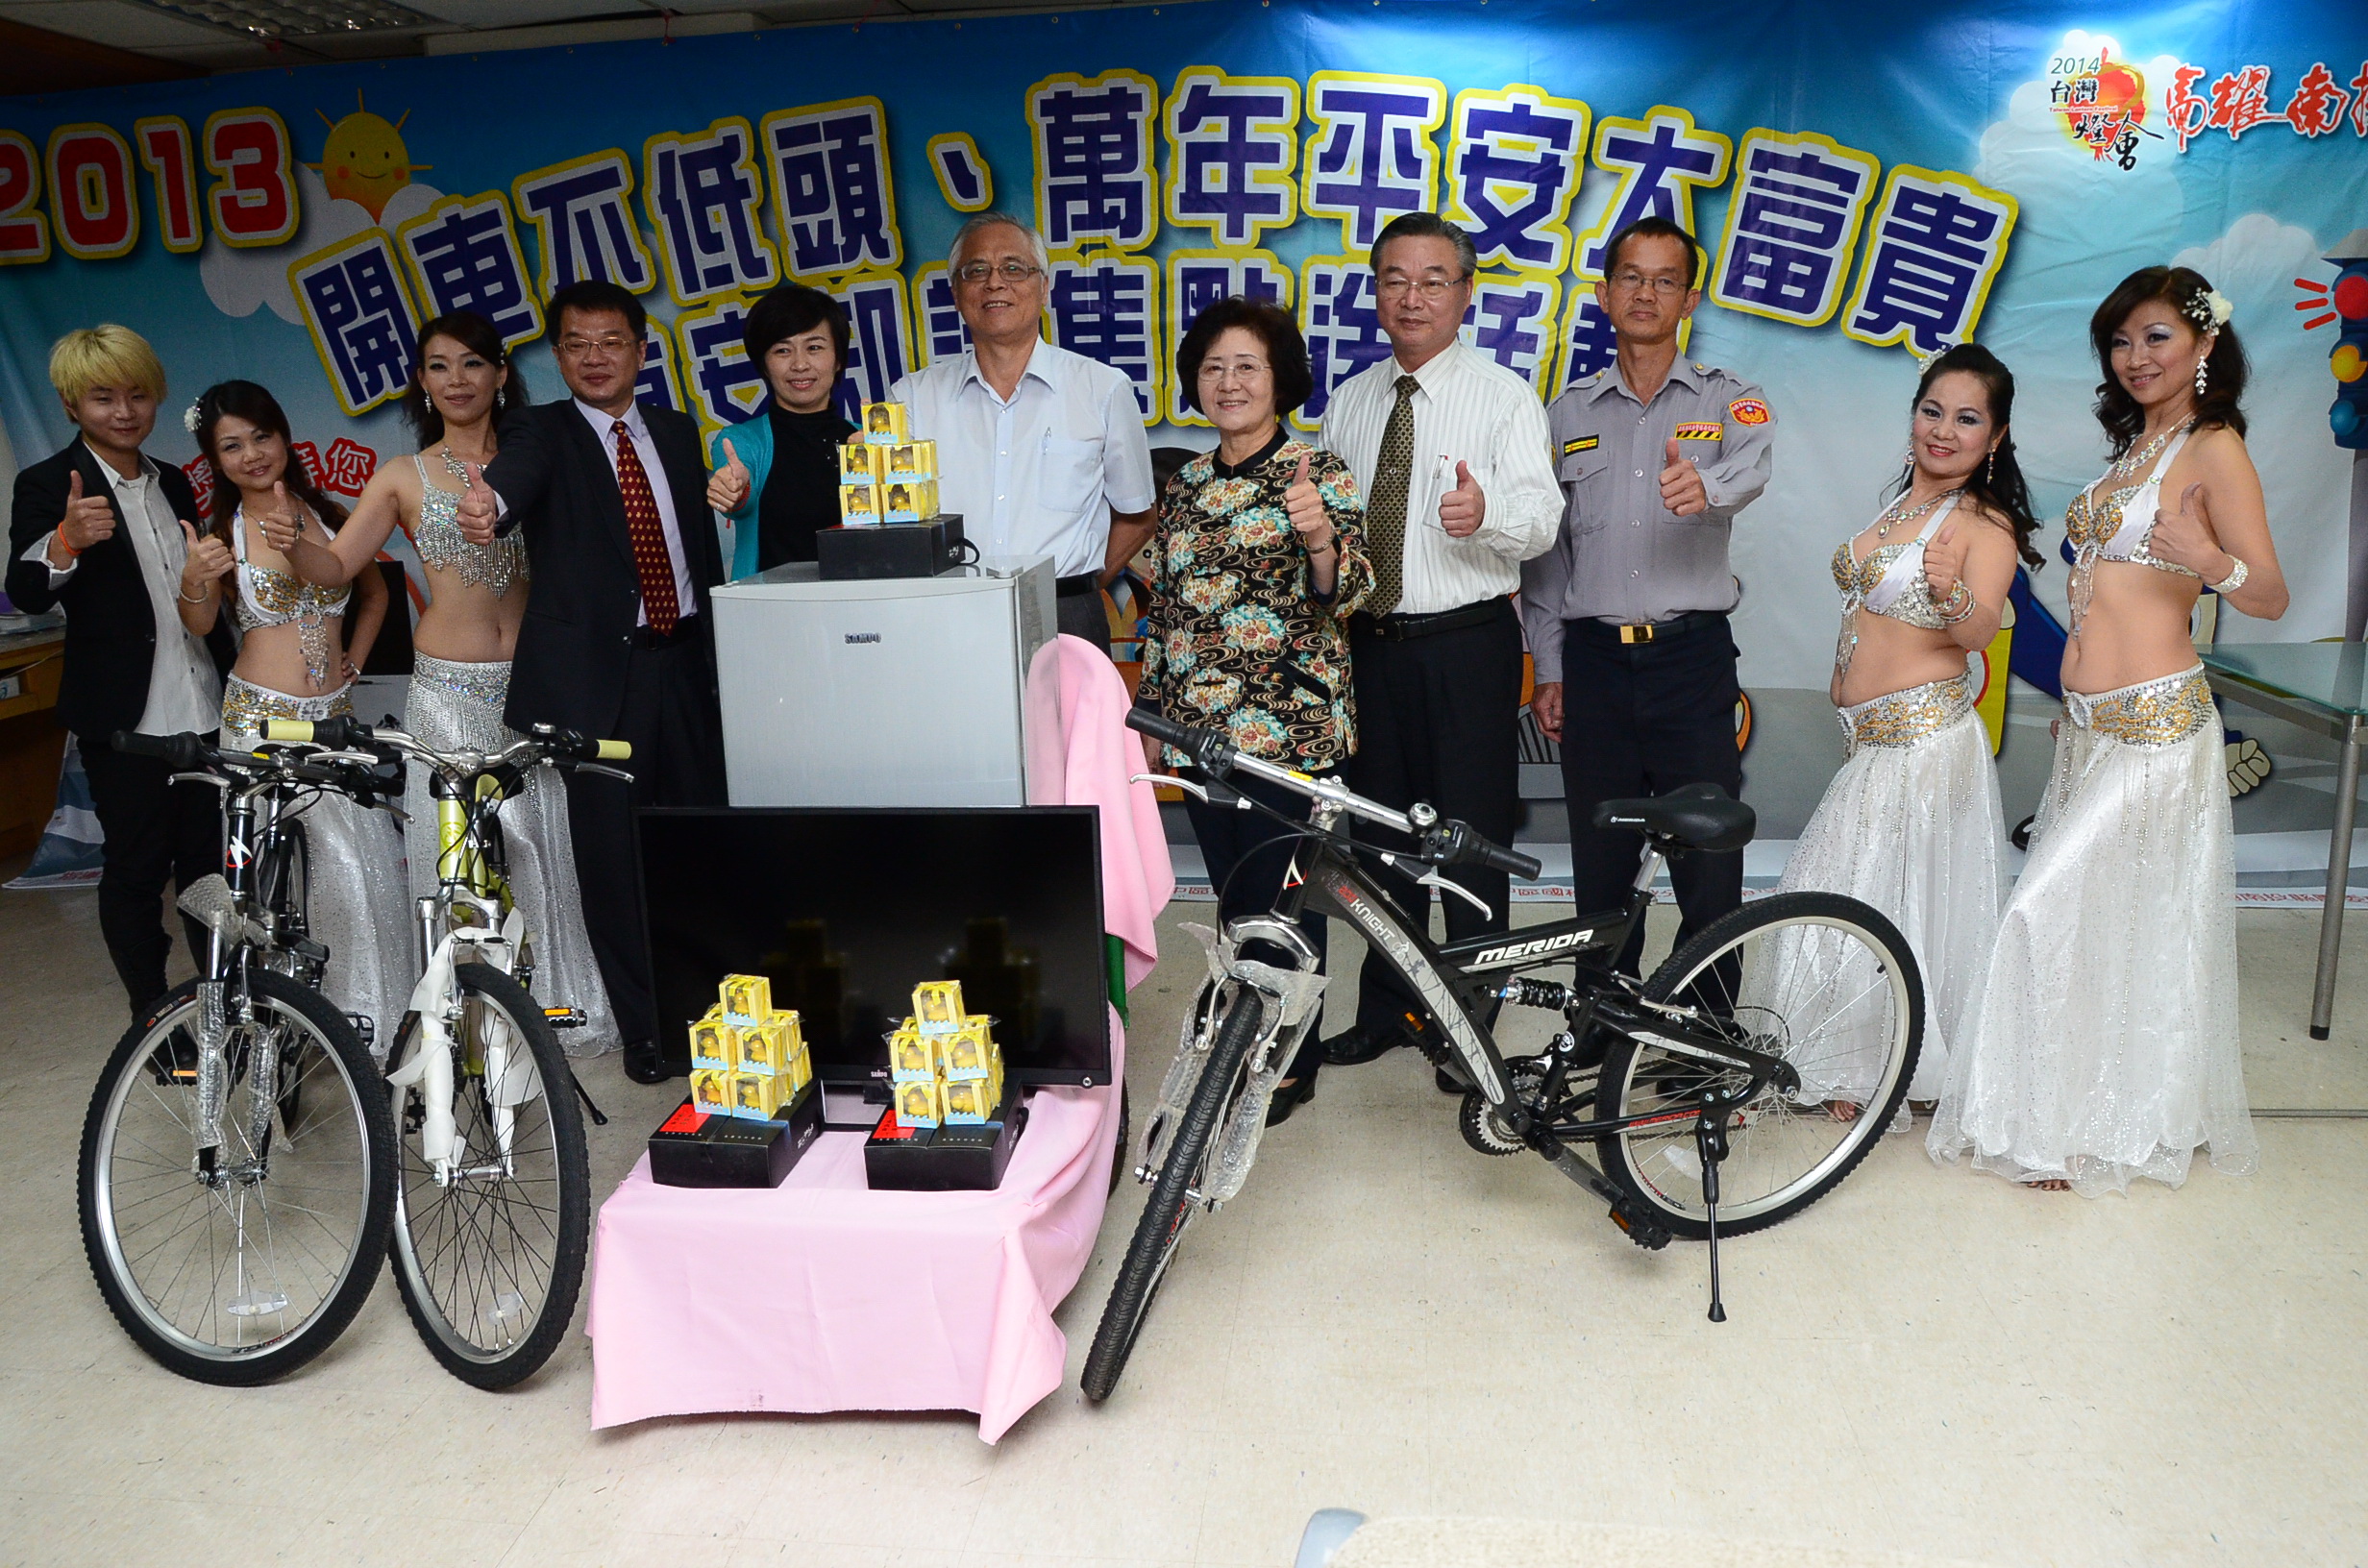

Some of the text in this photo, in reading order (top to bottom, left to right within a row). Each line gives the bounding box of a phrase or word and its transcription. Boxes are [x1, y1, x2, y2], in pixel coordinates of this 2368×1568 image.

[2050, 57, 2101, 74] 2014
[2050, 79, 2099, 104] 台灣
[1349, 897, 1396, 941] KNIGHT
[1473, 928, 1594, 965] MERIDA
